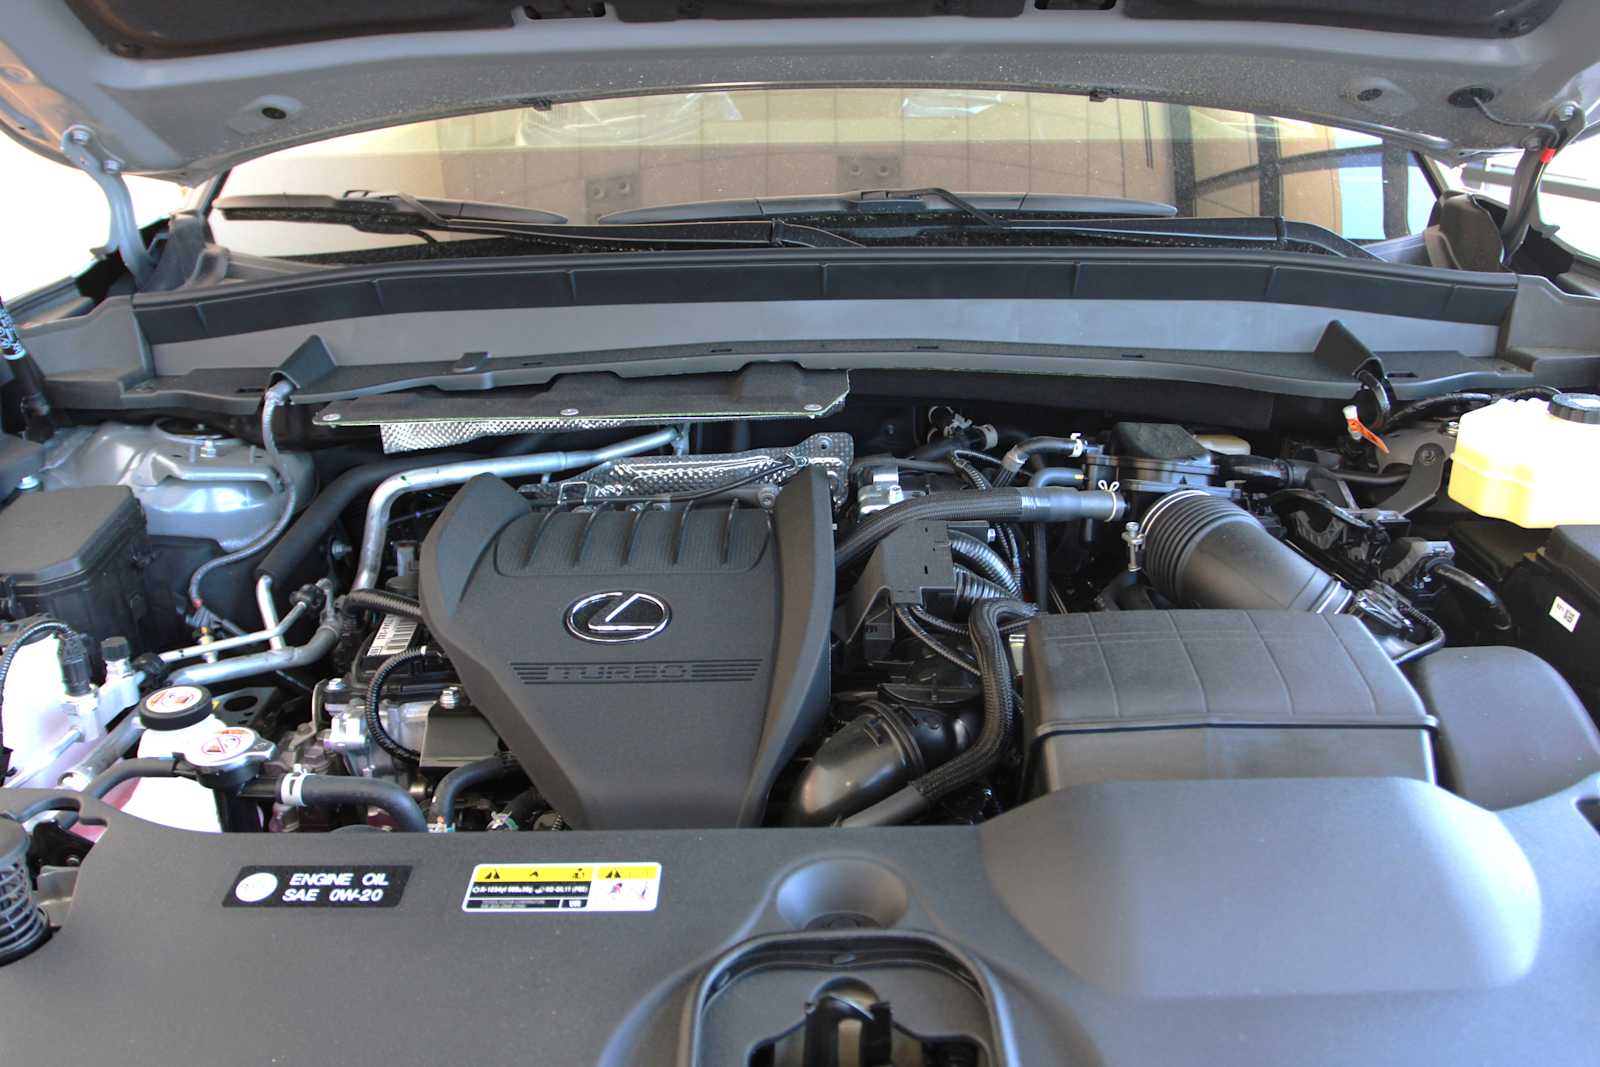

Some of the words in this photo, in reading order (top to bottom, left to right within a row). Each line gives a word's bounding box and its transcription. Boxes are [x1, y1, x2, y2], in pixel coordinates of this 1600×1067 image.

[552, 665, 688, 680] TURBO
[288, 872, 355, 886] ENGINE
[361, 872, 389, 886] OIL
[281, 888, 321, 902] SAE
[328, 888, 384, 902] 0W-20
